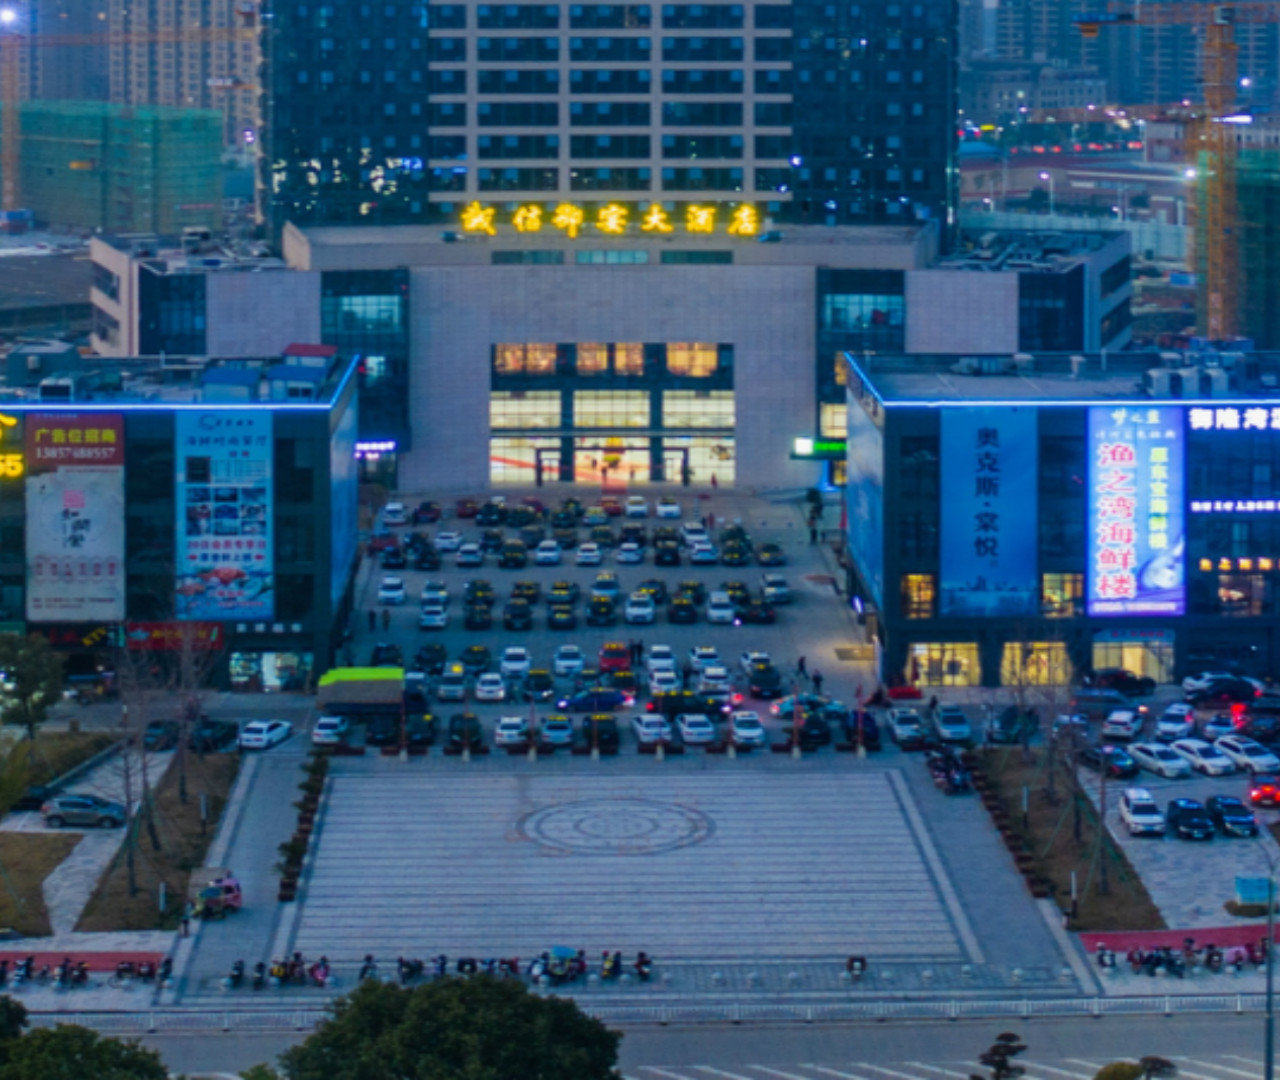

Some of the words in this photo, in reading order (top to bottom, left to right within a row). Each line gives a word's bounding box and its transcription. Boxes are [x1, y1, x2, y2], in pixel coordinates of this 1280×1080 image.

[1095, 441, 1137, 598] 渔之湾海鲜楼
